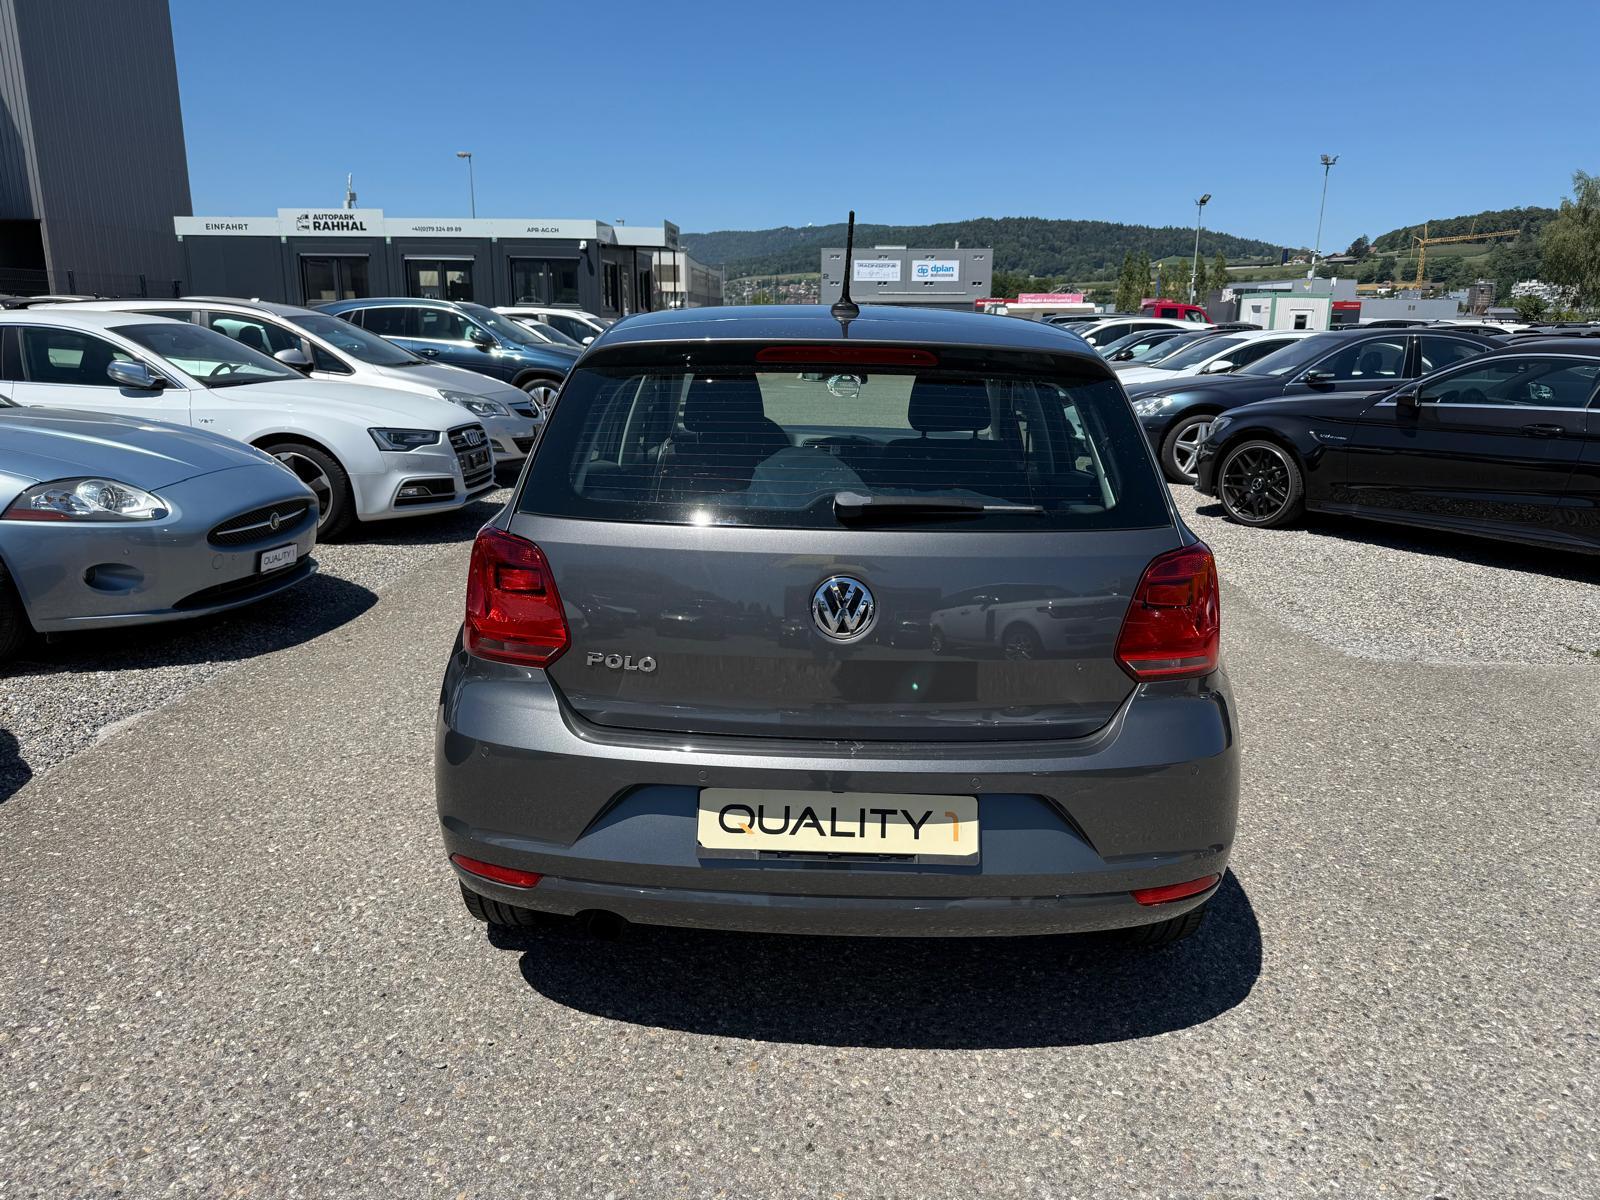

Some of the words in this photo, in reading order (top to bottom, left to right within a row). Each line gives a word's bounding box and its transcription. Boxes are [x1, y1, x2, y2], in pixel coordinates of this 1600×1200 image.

[205, 223, 249, 231] EINFAHRT
[313, 221, 367, 231] RAHHAL
[930, 264, 954, 273] dplan
[263, 550, 291, 565] QUALITY
[586, 651, 657, 672] POLO
[718, 803, 934, 840] QUALITY
